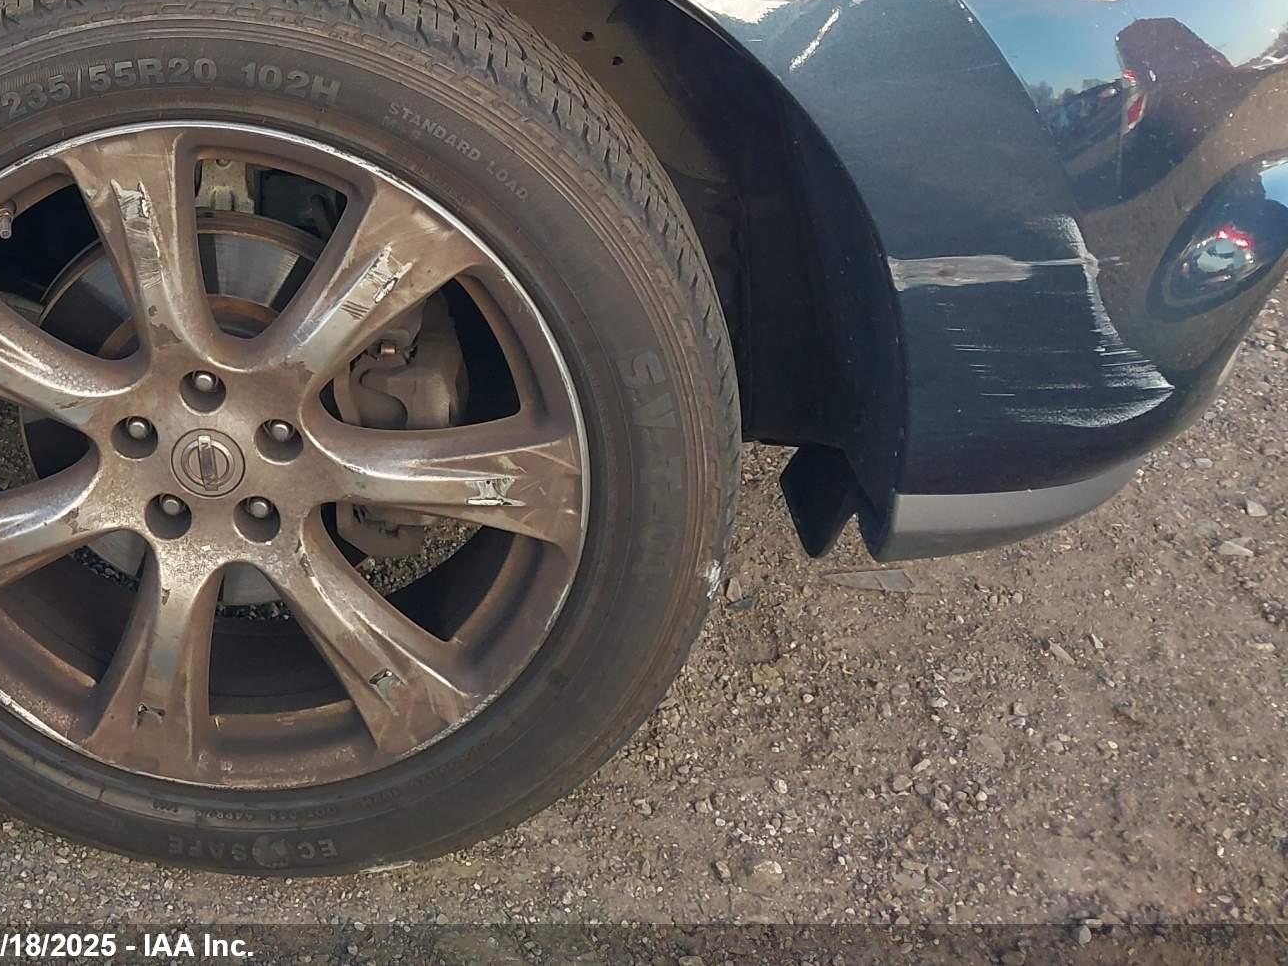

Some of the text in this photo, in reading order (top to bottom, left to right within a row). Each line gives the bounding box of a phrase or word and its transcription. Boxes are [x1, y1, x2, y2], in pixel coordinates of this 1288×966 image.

[241, 62, 342, 105] 102H
[388, 102, 481, 162] STANDARD
[486, 160, 530, 200] LOAD
